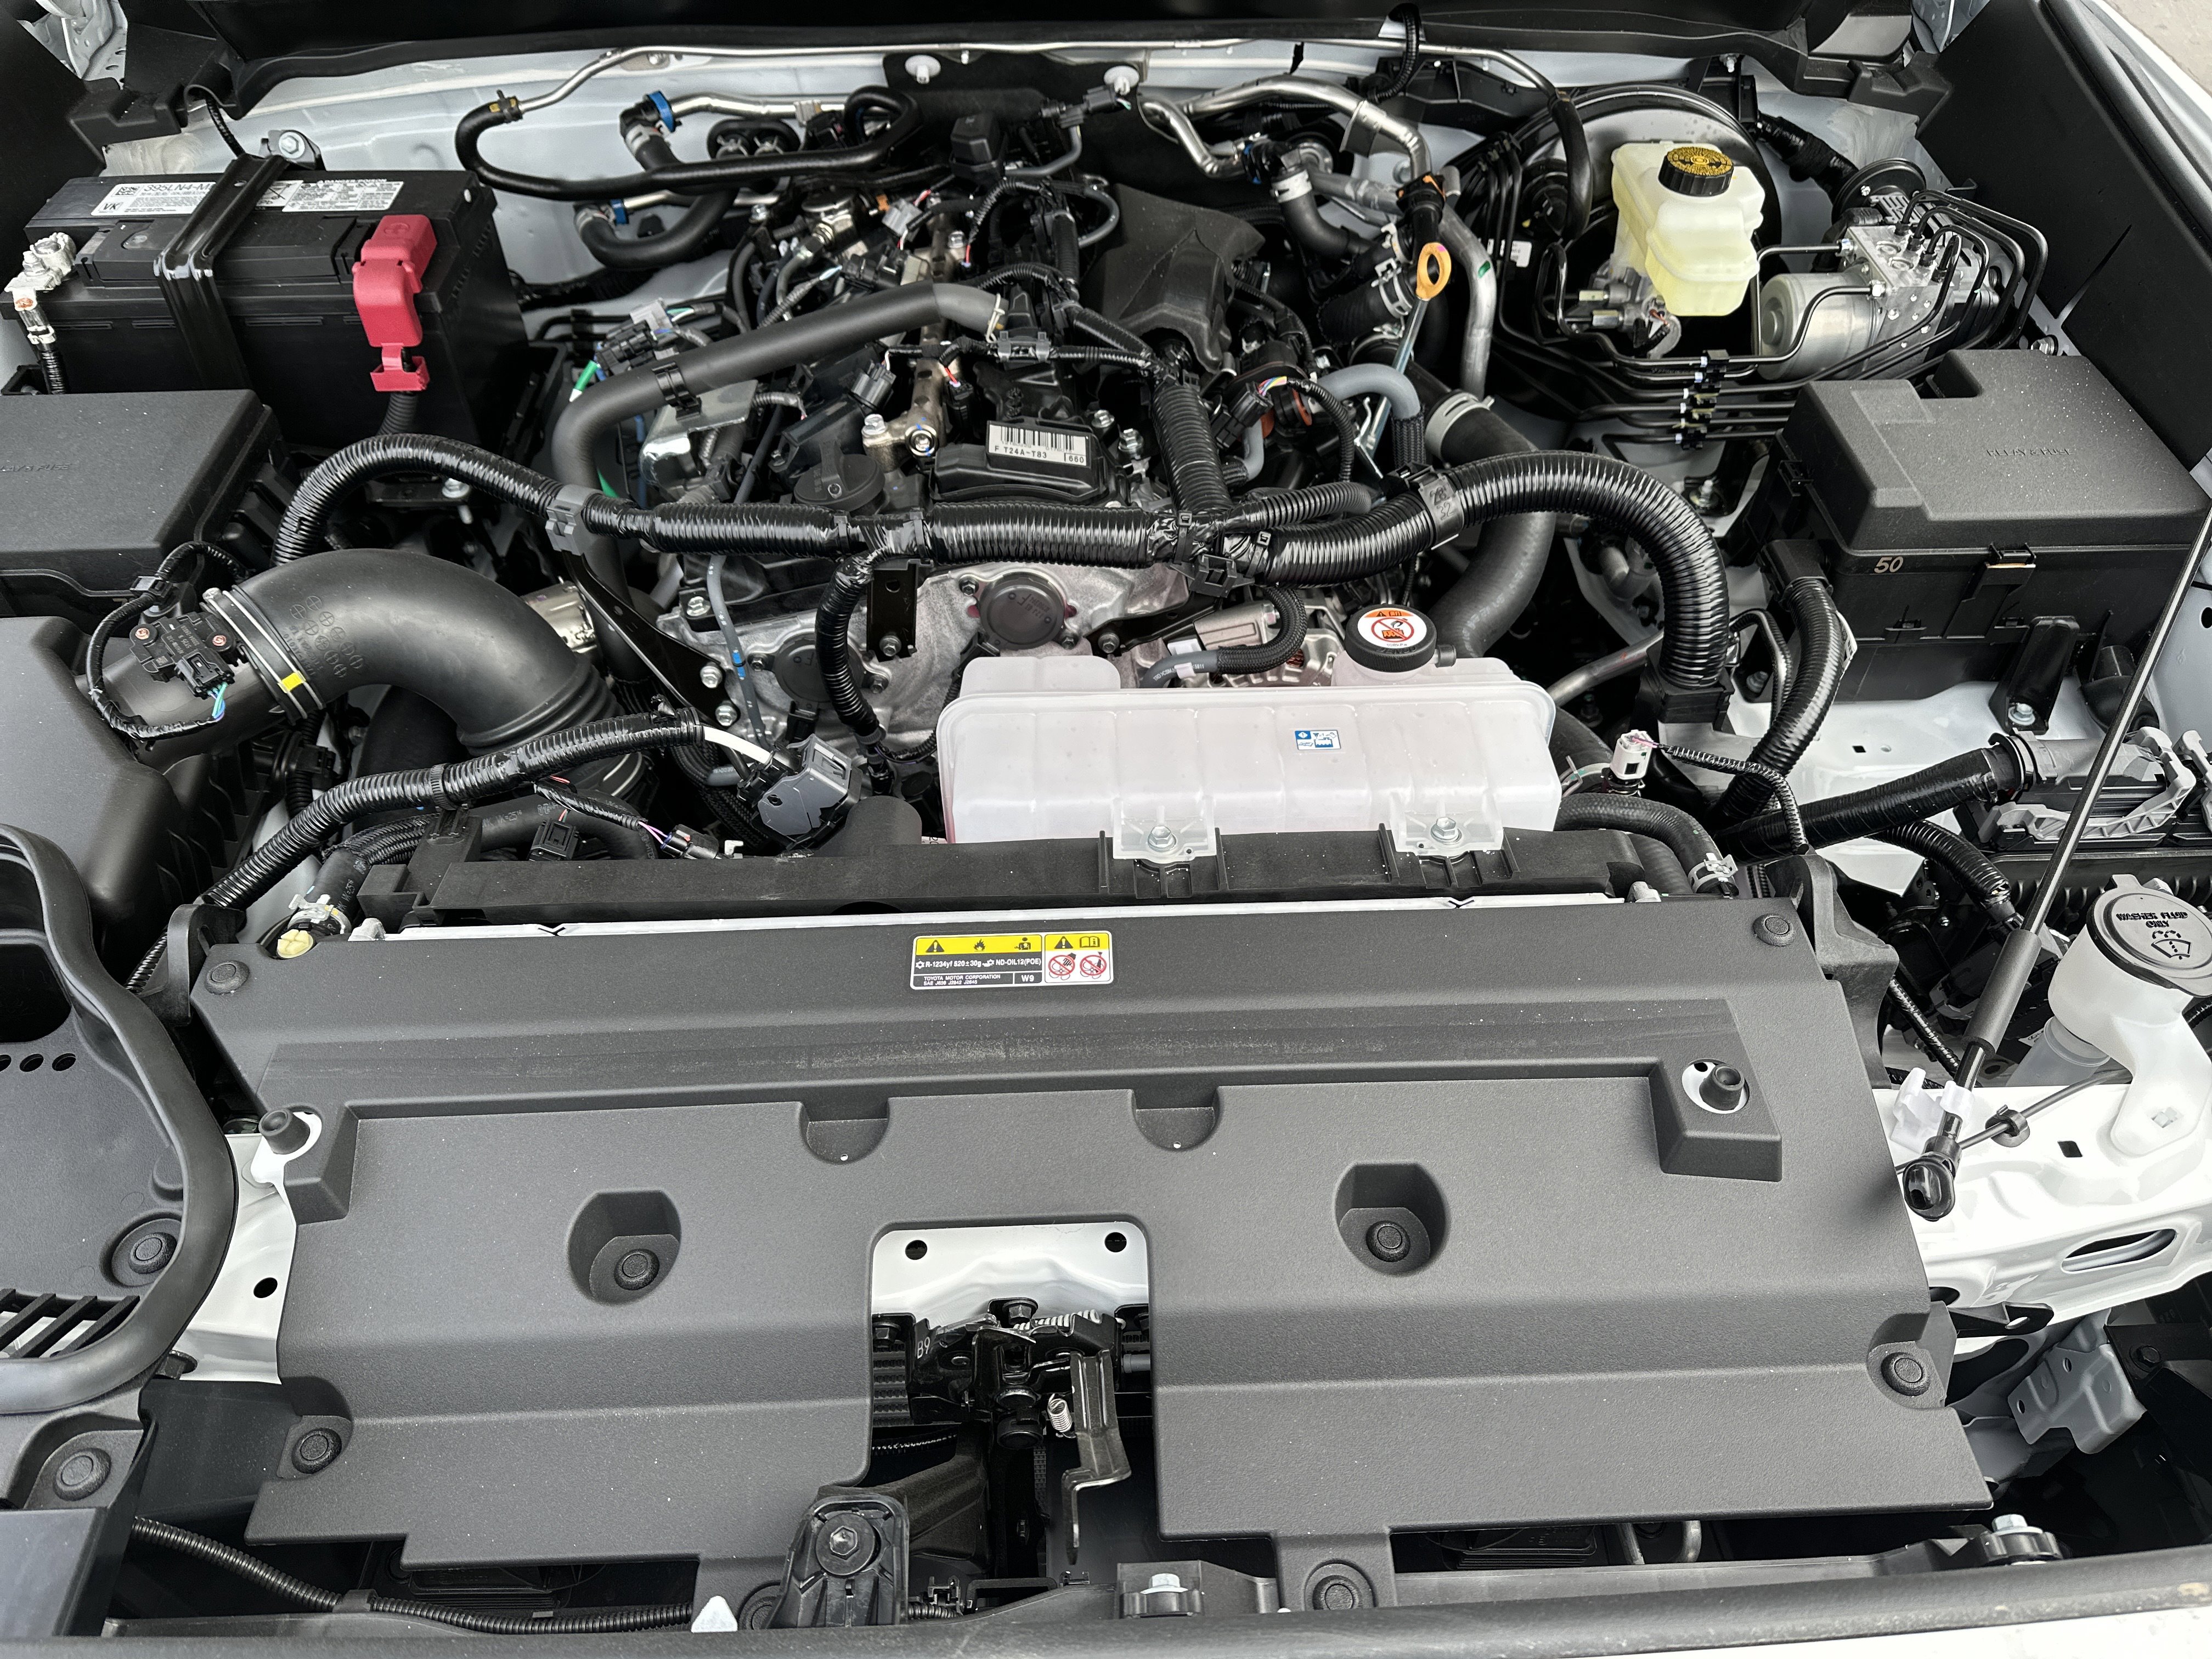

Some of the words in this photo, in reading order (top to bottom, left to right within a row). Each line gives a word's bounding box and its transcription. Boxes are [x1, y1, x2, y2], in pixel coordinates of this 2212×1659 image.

[1003, 447, 1047, 459] T24A-T83
[1874, 556, 1904, 573] 50
[2116, 912, 2158, 921] WASHER
[2160, 911, 2188, 919] FLUID
[2146, 920, 2170, 928] ONLY
[925, 961, 952, 969] R-1234yf
[953, 960, 981, 968] 520±30g
[995, 958, 1042, 966] ND-OIL12(POE)
[917, 1336, 930, 1359] B9
